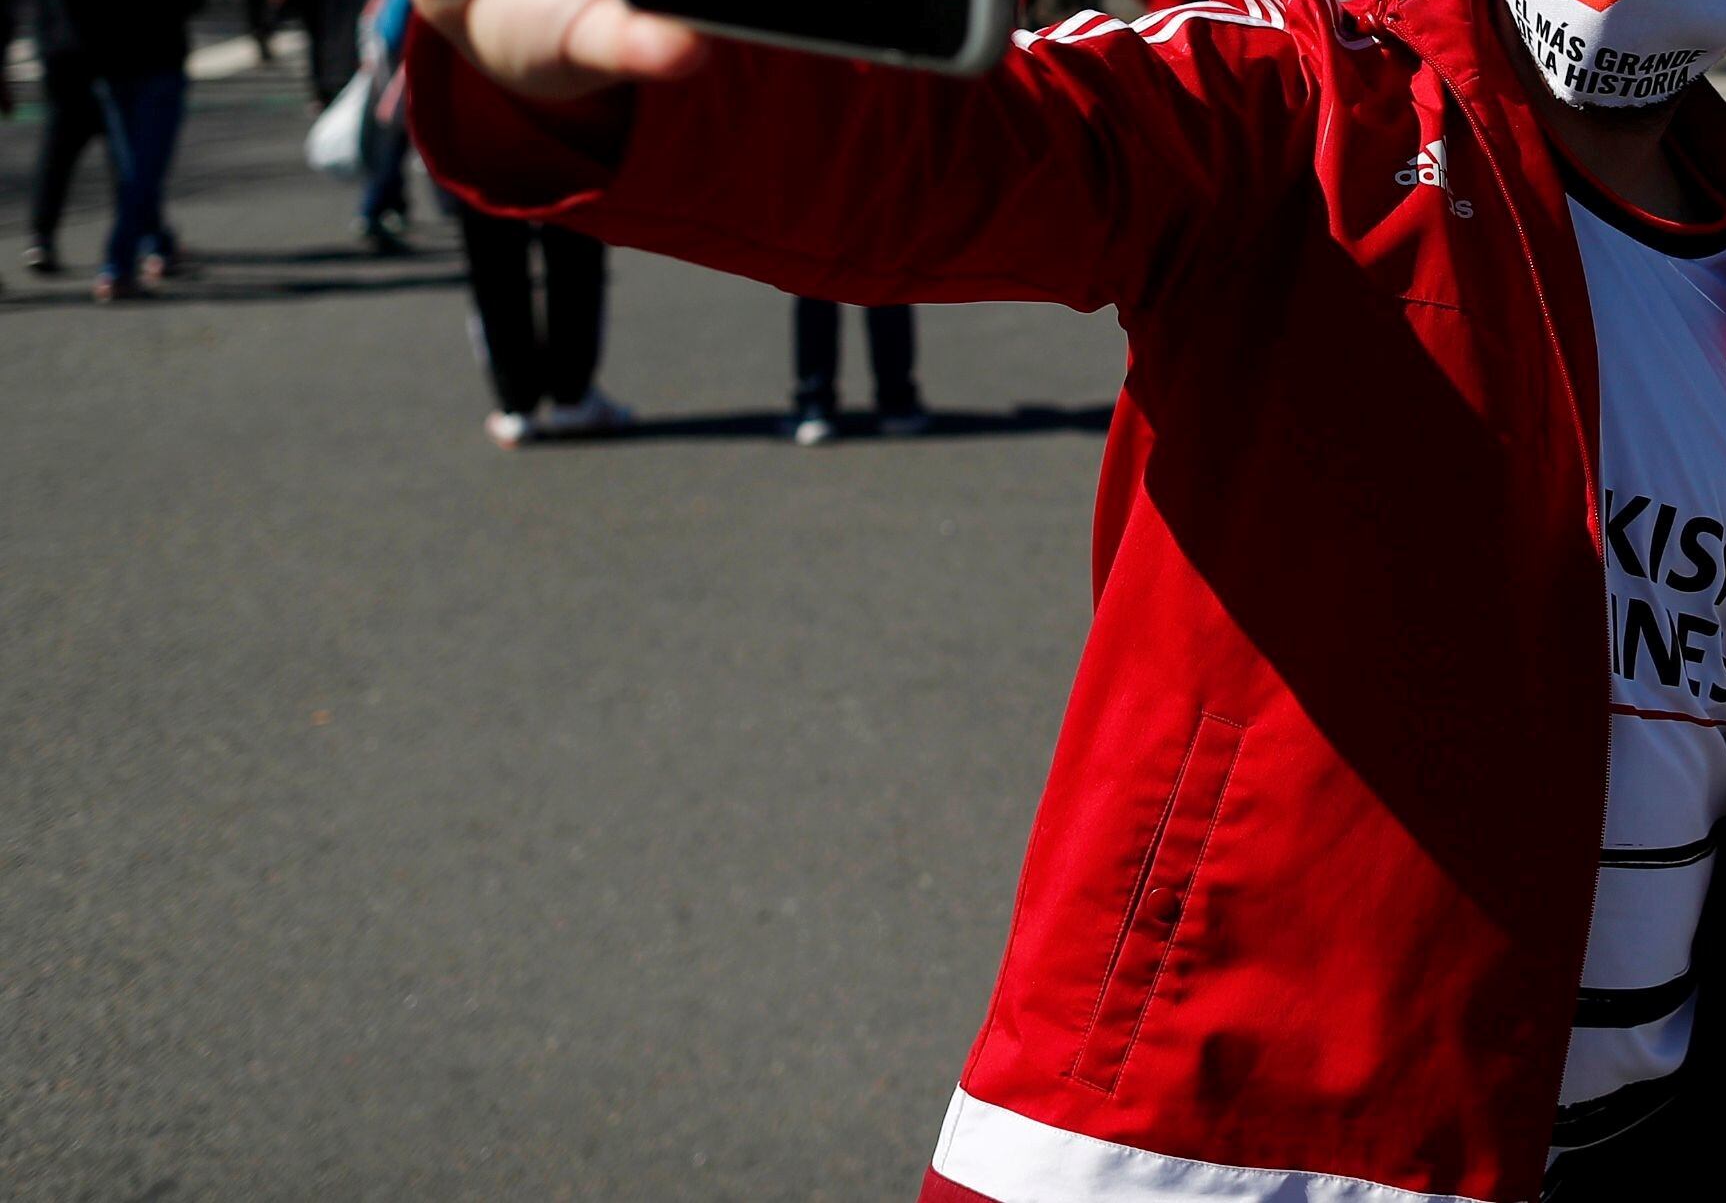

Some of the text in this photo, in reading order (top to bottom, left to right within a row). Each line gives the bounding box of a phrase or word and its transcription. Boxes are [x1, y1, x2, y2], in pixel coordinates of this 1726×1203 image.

[1535, 12, 1586, 63] MÁS
[1594, 47, 1708, 77] GR4NDE
[1537, 40, 1558, 76] LA
[1564, 64, 1691, 99] HISTORIA
